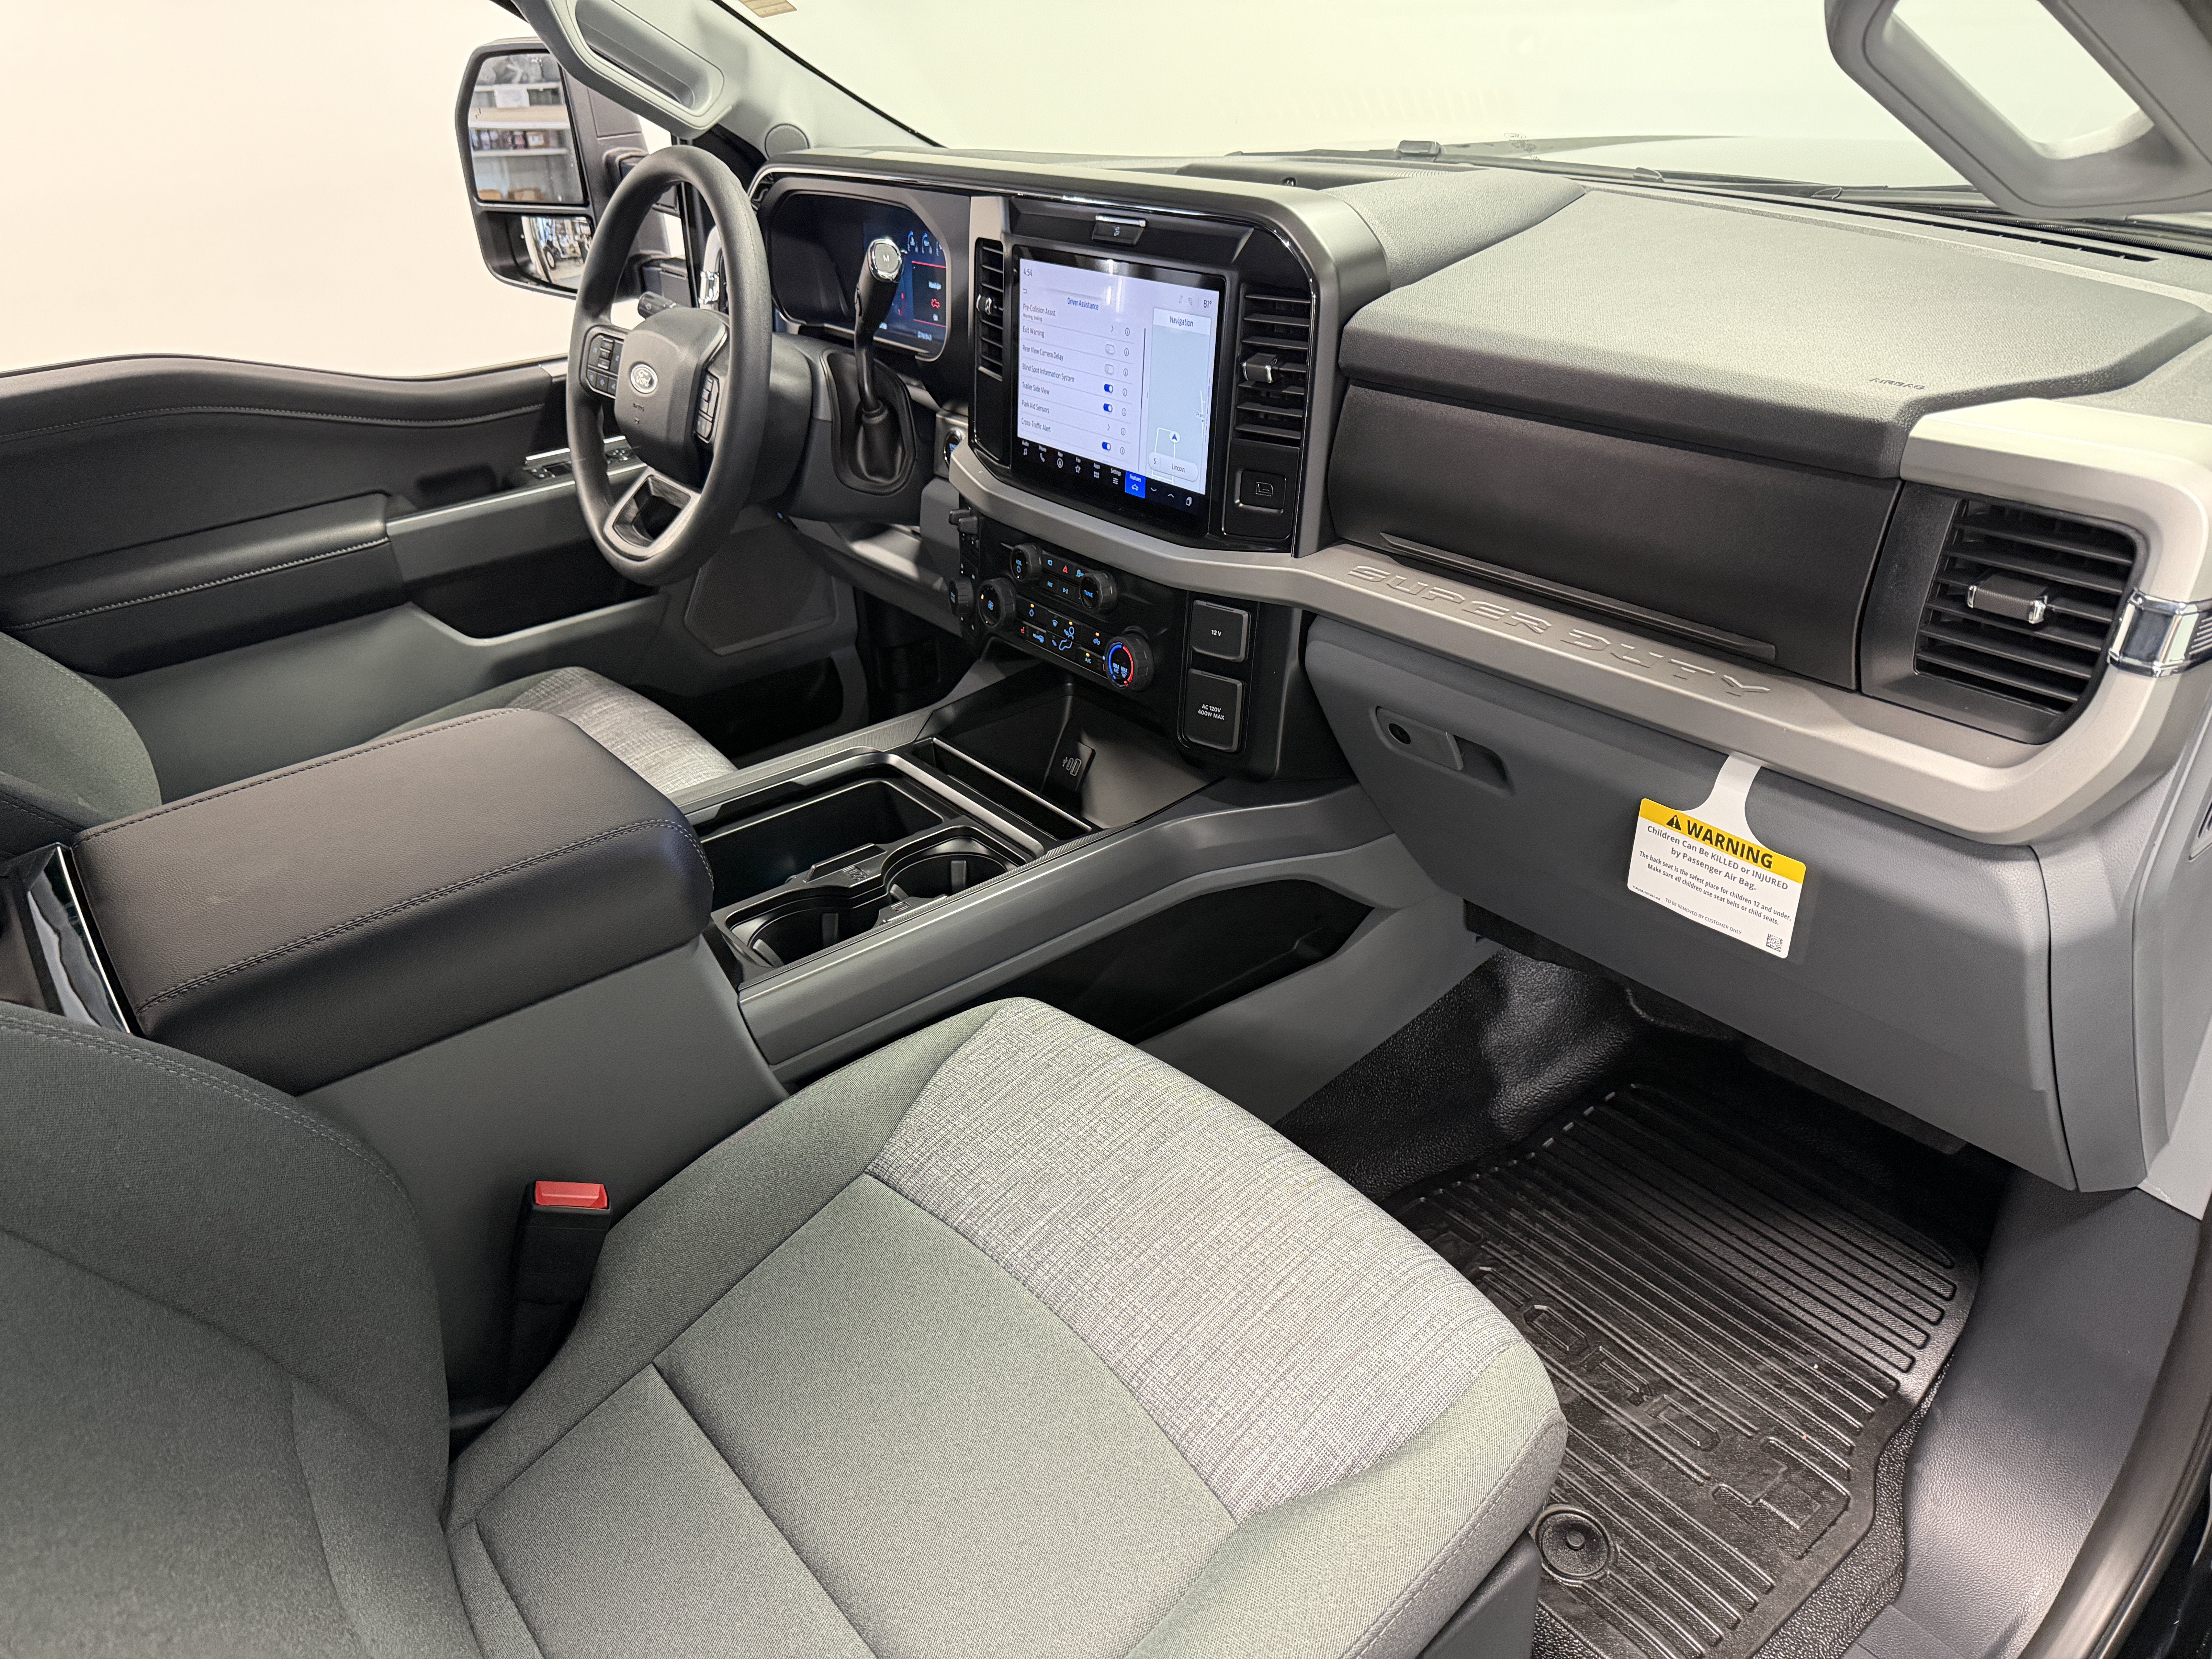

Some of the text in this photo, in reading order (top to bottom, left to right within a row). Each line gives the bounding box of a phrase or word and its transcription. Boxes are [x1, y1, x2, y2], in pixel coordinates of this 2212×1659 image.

[883, 254, 890, 262] M
[1023, 303, 1056, 316] Pre-Collision Assist
[1067, 297, 1099, 310] Driver Assistance
[1170, 316, 1194, 328] Navigation
[1030, 328, 1044, 338] Warning
[1040, 349, 1053, 358] Camera
[1053, 352, 1063, 362] Delay
[636, 369, 651, 387] Ford
[1022, 363, 1075, 383] Blind Spot Information System
[1022, 381, 1032, 390] Trailer
[1869, 378, 1926, 390] AIRBAG
[1036, 404, 1049, 414] Sensors
[1021, 417, 1051, 433] Cross-Traffic Alert
[1172, 463, 1185, 473] Lincoln
[1348, 565, 1771, 697] SUPER DUTY
[1197, 709, 1212, 717] 400W
[1687, 819, 1773, 869] WARNING
[1647, 826, 1680, 845] Children
[1682, 840, 1697, 852] Can
[1699, 847, 1709, 857] Be
[1711, 852, 1738, 869] KILLED
[1752, 870, 1788, 890] INJURED
[1671, 847, 1756, 891] by Passenger Air Bag.
[1640, 850, 1649, 859] The
[1650, 855, 1661, 865] back
[1662, 862, 1673, 870] seat
[1689, 874, 1704, 884] safest
[1705, 881, 1719, 890] place
[1729, 891, 1752, 904] children
[1773, 910, 1791, 921] under.
[1647, 863, 1661, 874] Make
[1663, 871, 1673, 879] sure
[1682, 879, 1702, 893] children
[1714, 894, 1725, 902] seat
[1726, 898, 1740, 908] belts
[1748, 908, 1762, 918] child
[1763, 915, 1779, 925] seats.
[1678, 904, 1698, 917] REMOVED
[1705, 917, 1729, 930] CUSTOMER
[1729, 927, 1742, 935] ONLY
